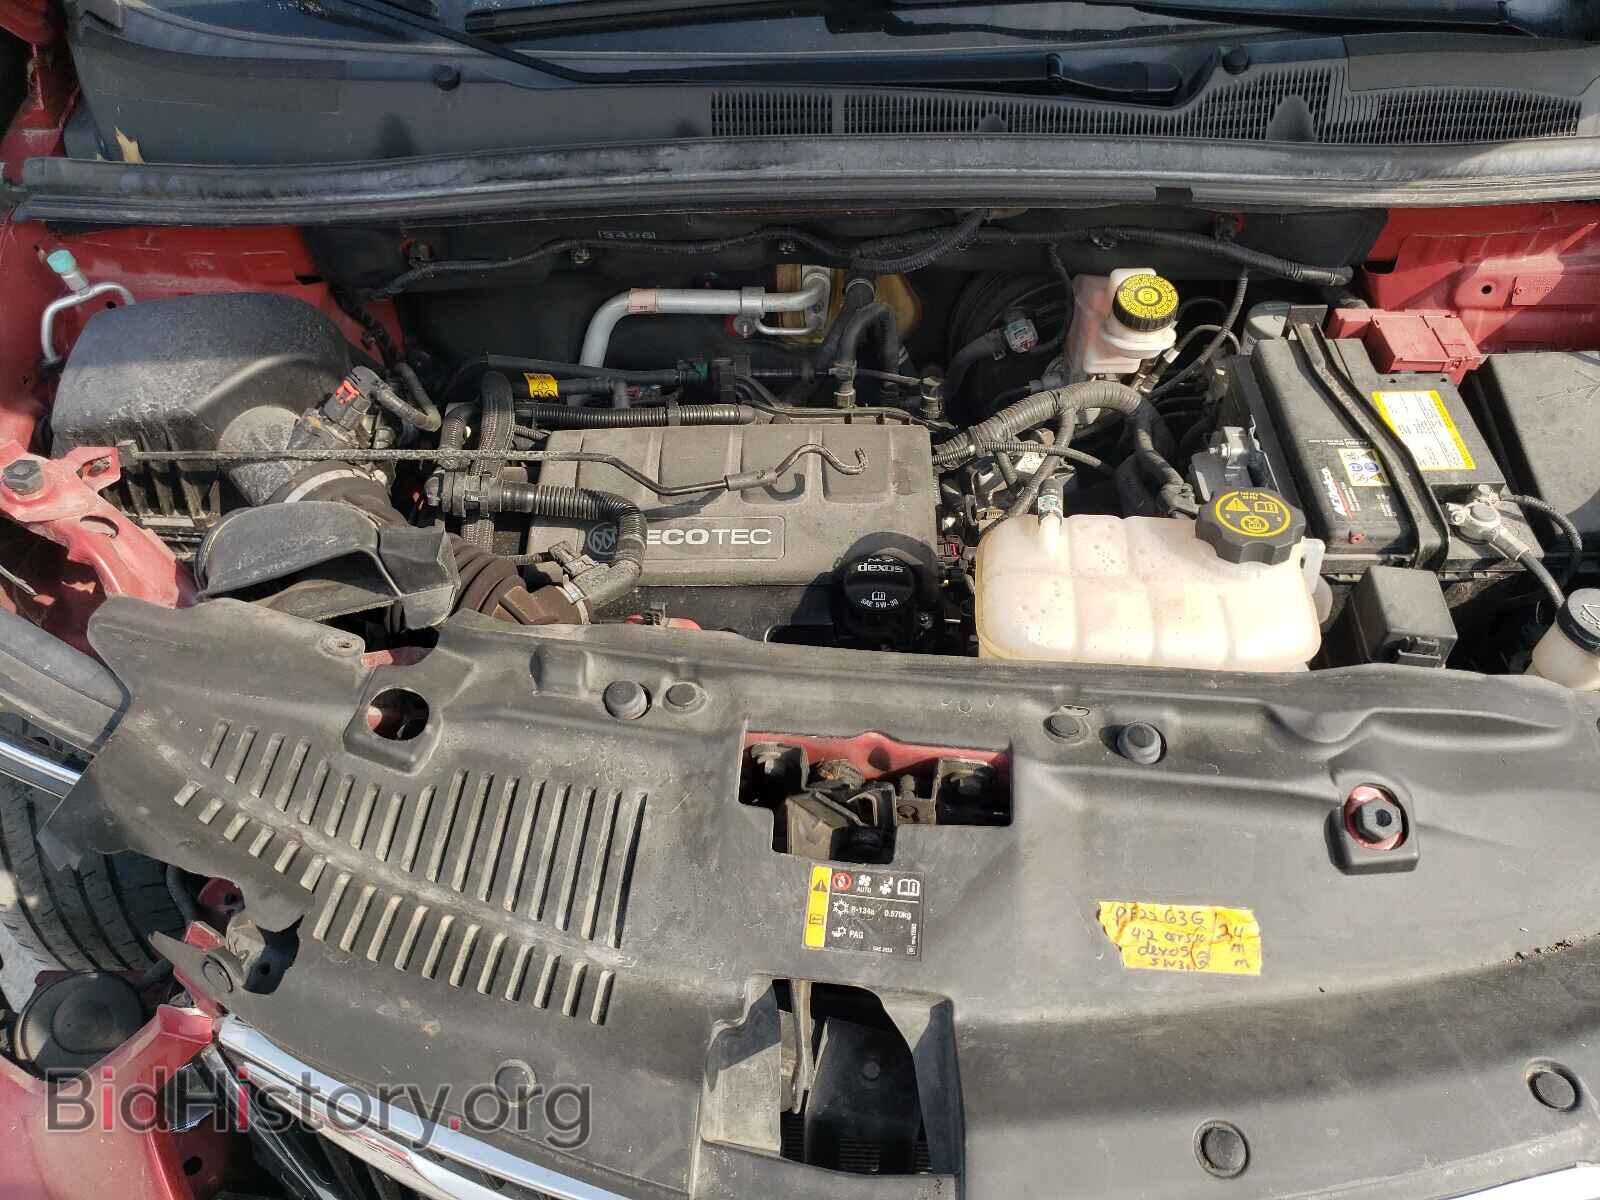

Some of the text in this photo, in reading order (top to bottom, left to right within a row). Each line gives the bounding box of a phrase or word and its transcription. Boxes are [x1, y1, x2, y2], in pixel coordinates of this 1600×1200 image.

[646, 528, 773, 546] ECOTEC
[857, 562, 905, 573] dexos
[856, 886, 872, 894] AUTO
[849, 929, 864, 940] PAG
